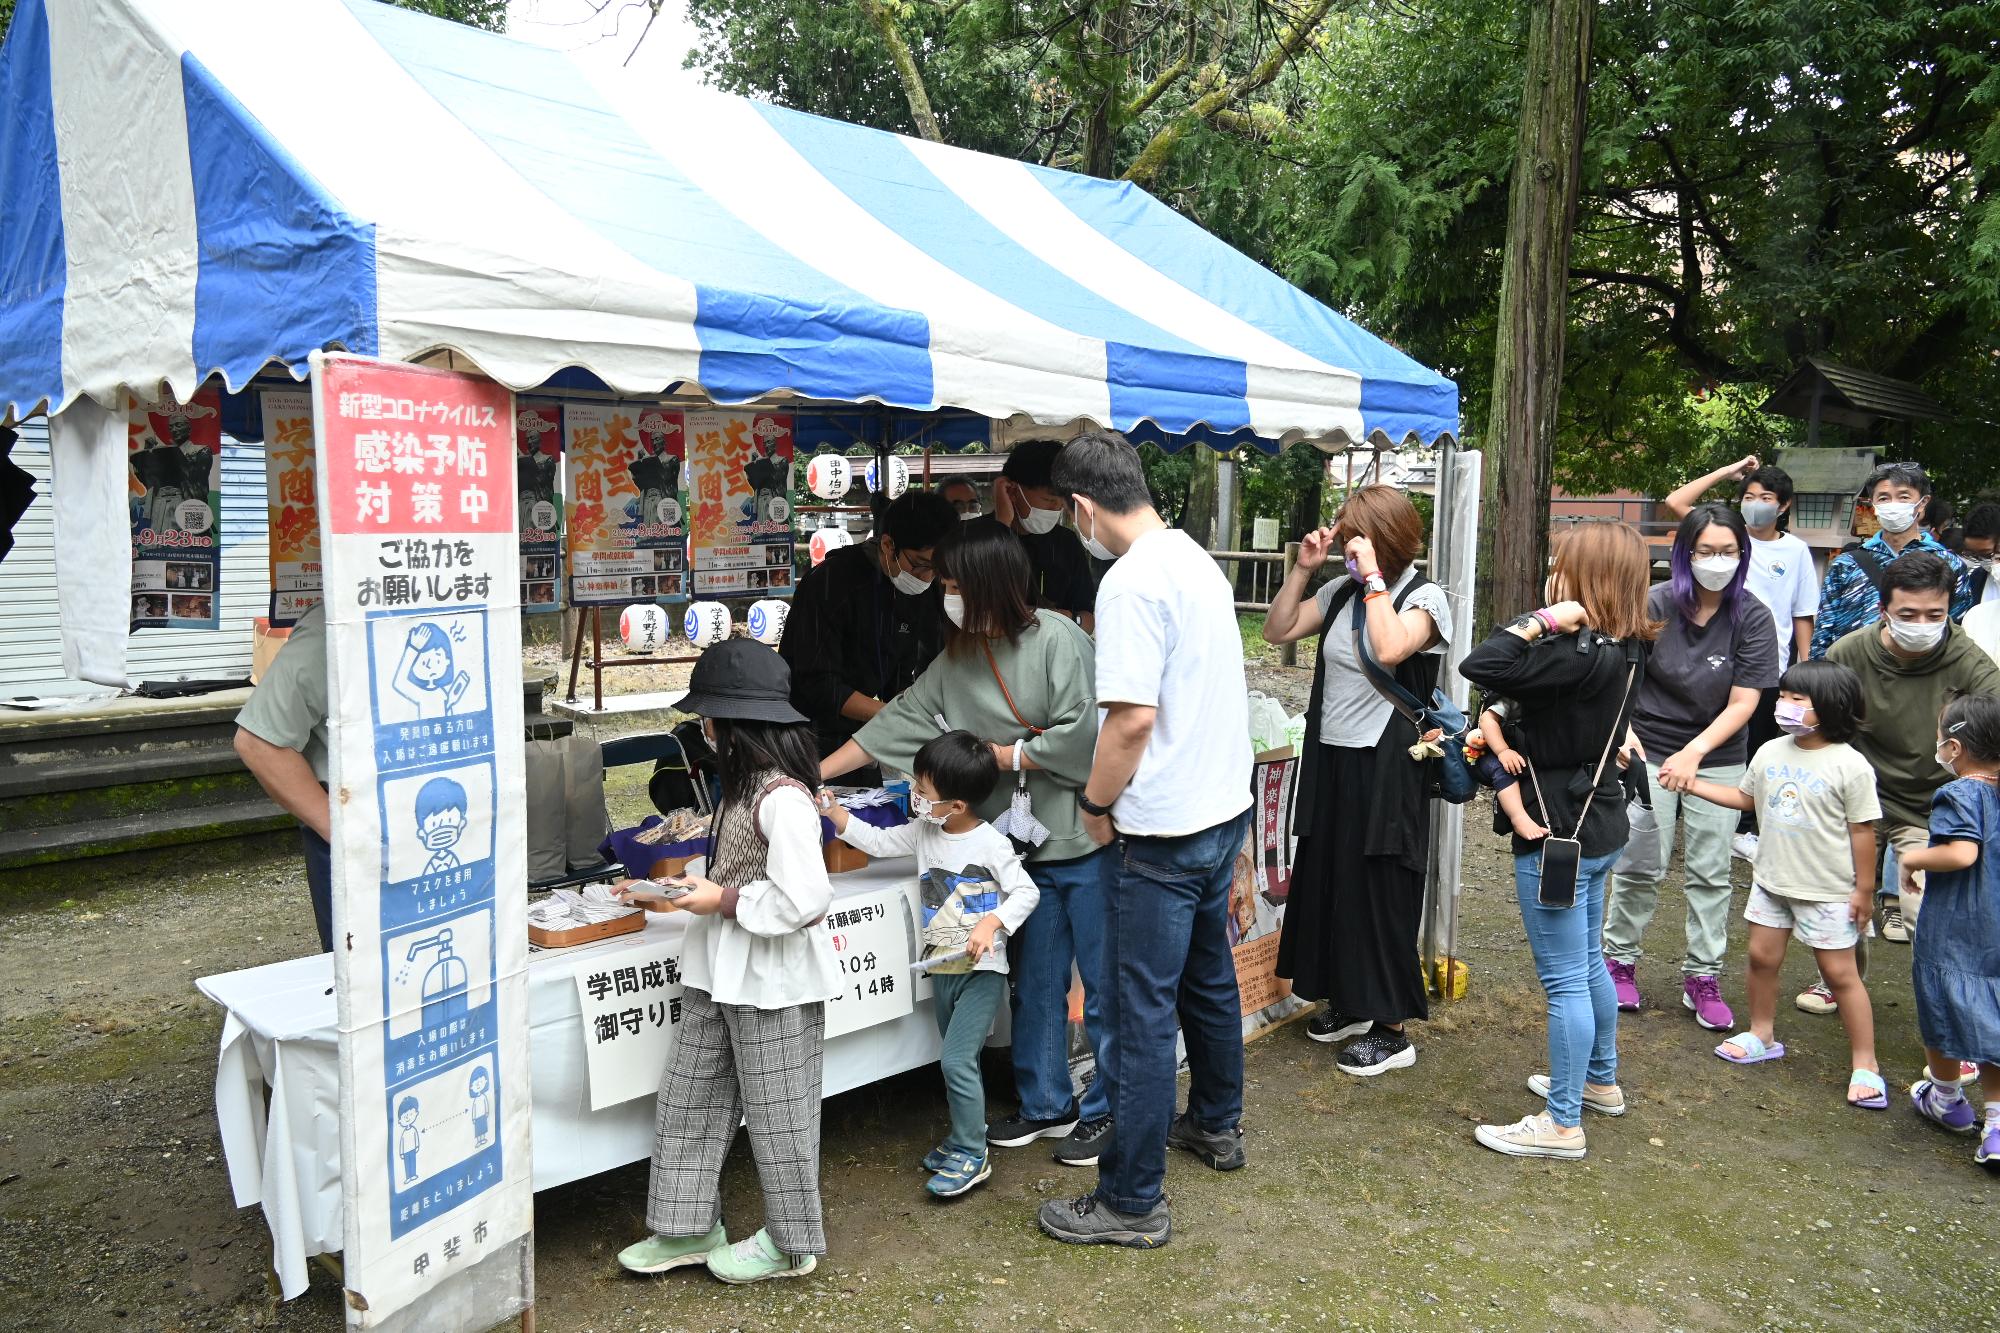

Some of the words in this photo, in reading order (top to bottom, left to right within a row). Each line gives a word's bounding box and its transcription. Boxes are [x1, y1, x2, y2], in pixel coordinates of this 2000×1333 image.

[338, 391, 497, 428] 新型コロナウイルス
[354, 429, 488, 477] 感染予防
[355, 480, 489, 524] 対策中
[378, 538, 475, 569] ご協力を
[357, 572, 492, 607] お願いします
[399, 719, 474, 742] 発熱のある方の
[1266, 767, 1282, 847] 神楽奉納
[410, 867, 473, 896] マスクを着用
[416, 888, 468, 914] しましょう
[416, 1016, 467, 1048] 入場の際は
[395, 1026, 487, 1076] 消毒をお願いします
[400, 1160, 495, 1222] 距離をとりましょう
[413, 1219, 489, 1277] 甲斐市
